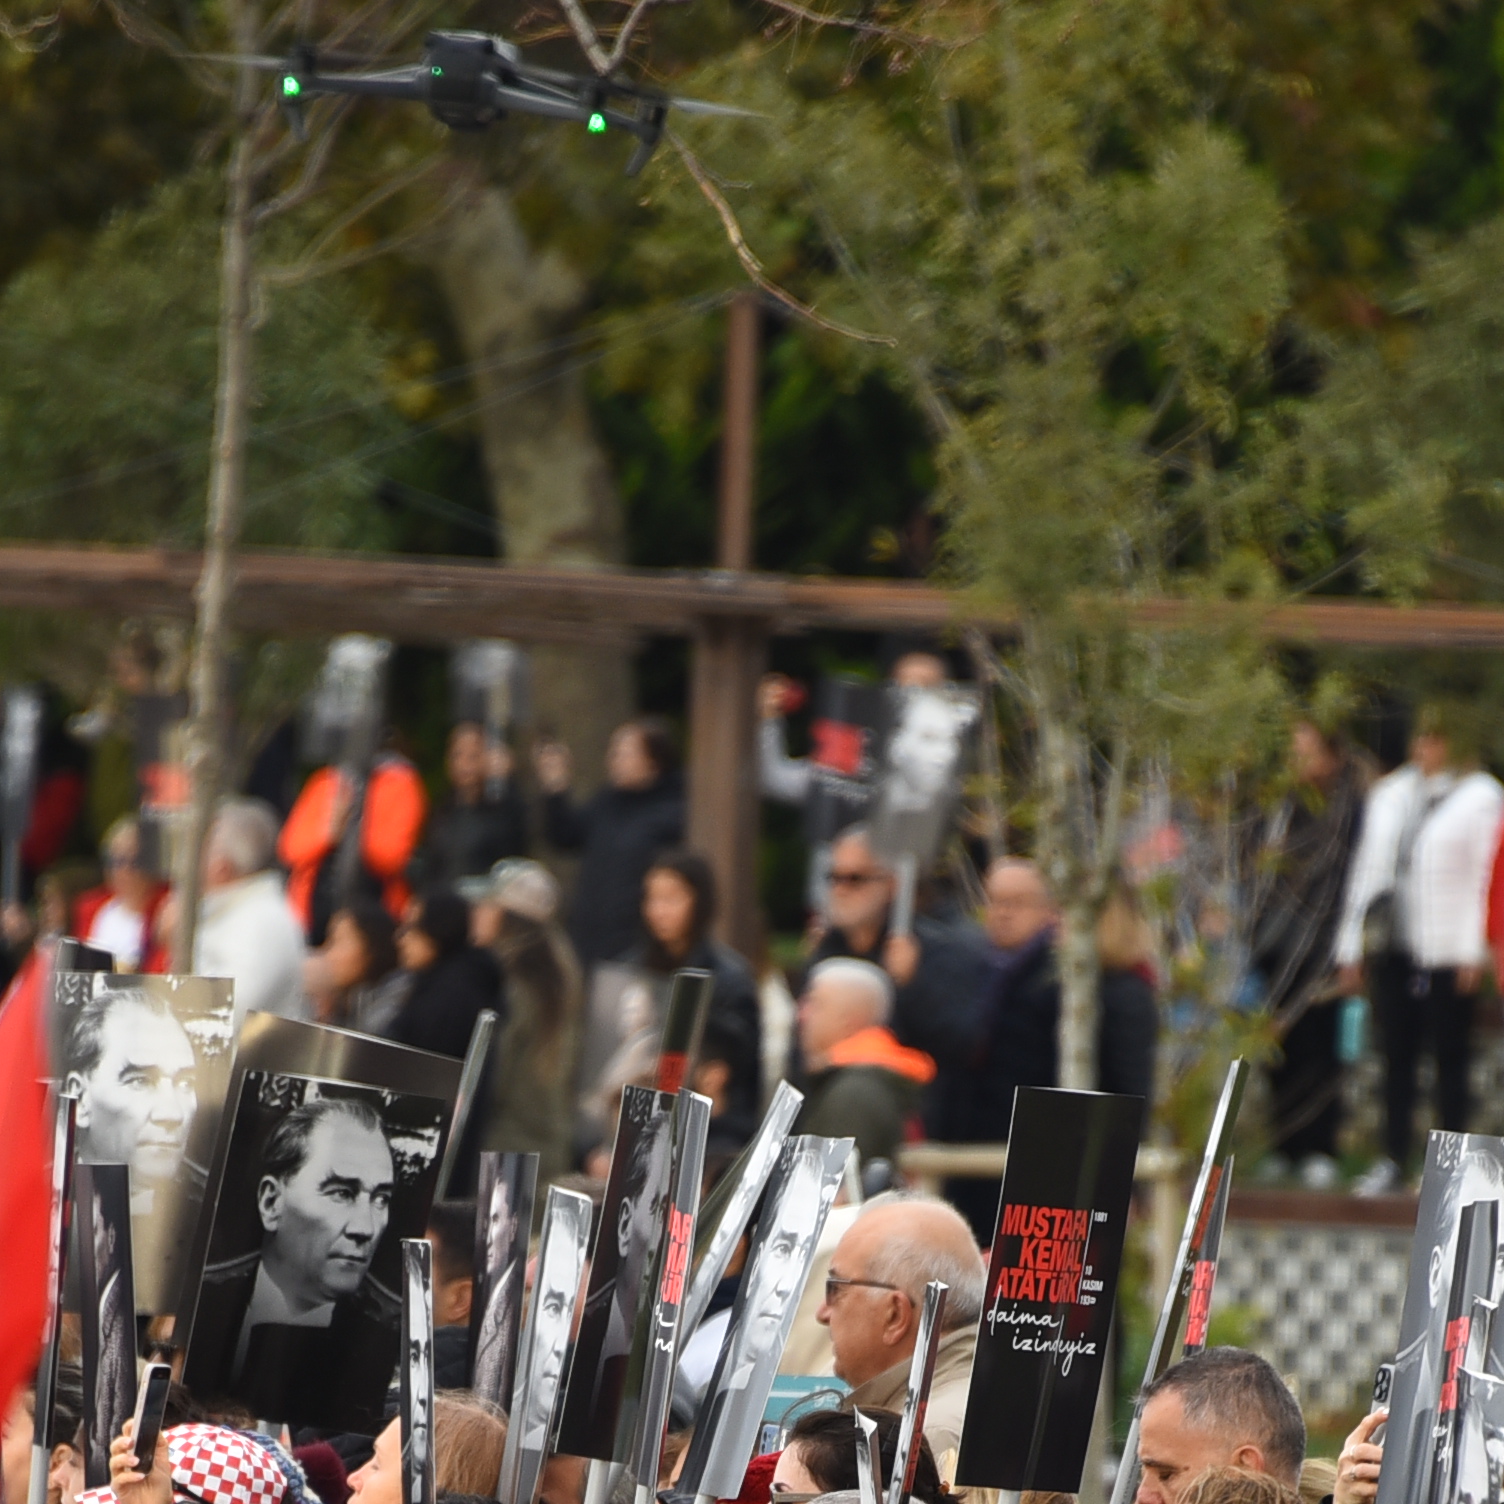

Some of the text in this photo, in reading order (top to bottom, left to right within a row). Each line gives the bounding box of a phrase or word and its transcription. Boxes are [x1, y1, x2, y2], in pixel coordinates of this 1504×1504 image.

[1001, 1204, 1088, 1240] MUSTAFA
[1019, 1237, 1081, 1271] KEMAL
[993, 1267, 1080, 1303] ATATÜRK
[987, 1284, 1060, 1336] daima
[1012, 1314, 1096, 1377] izindeyiz
